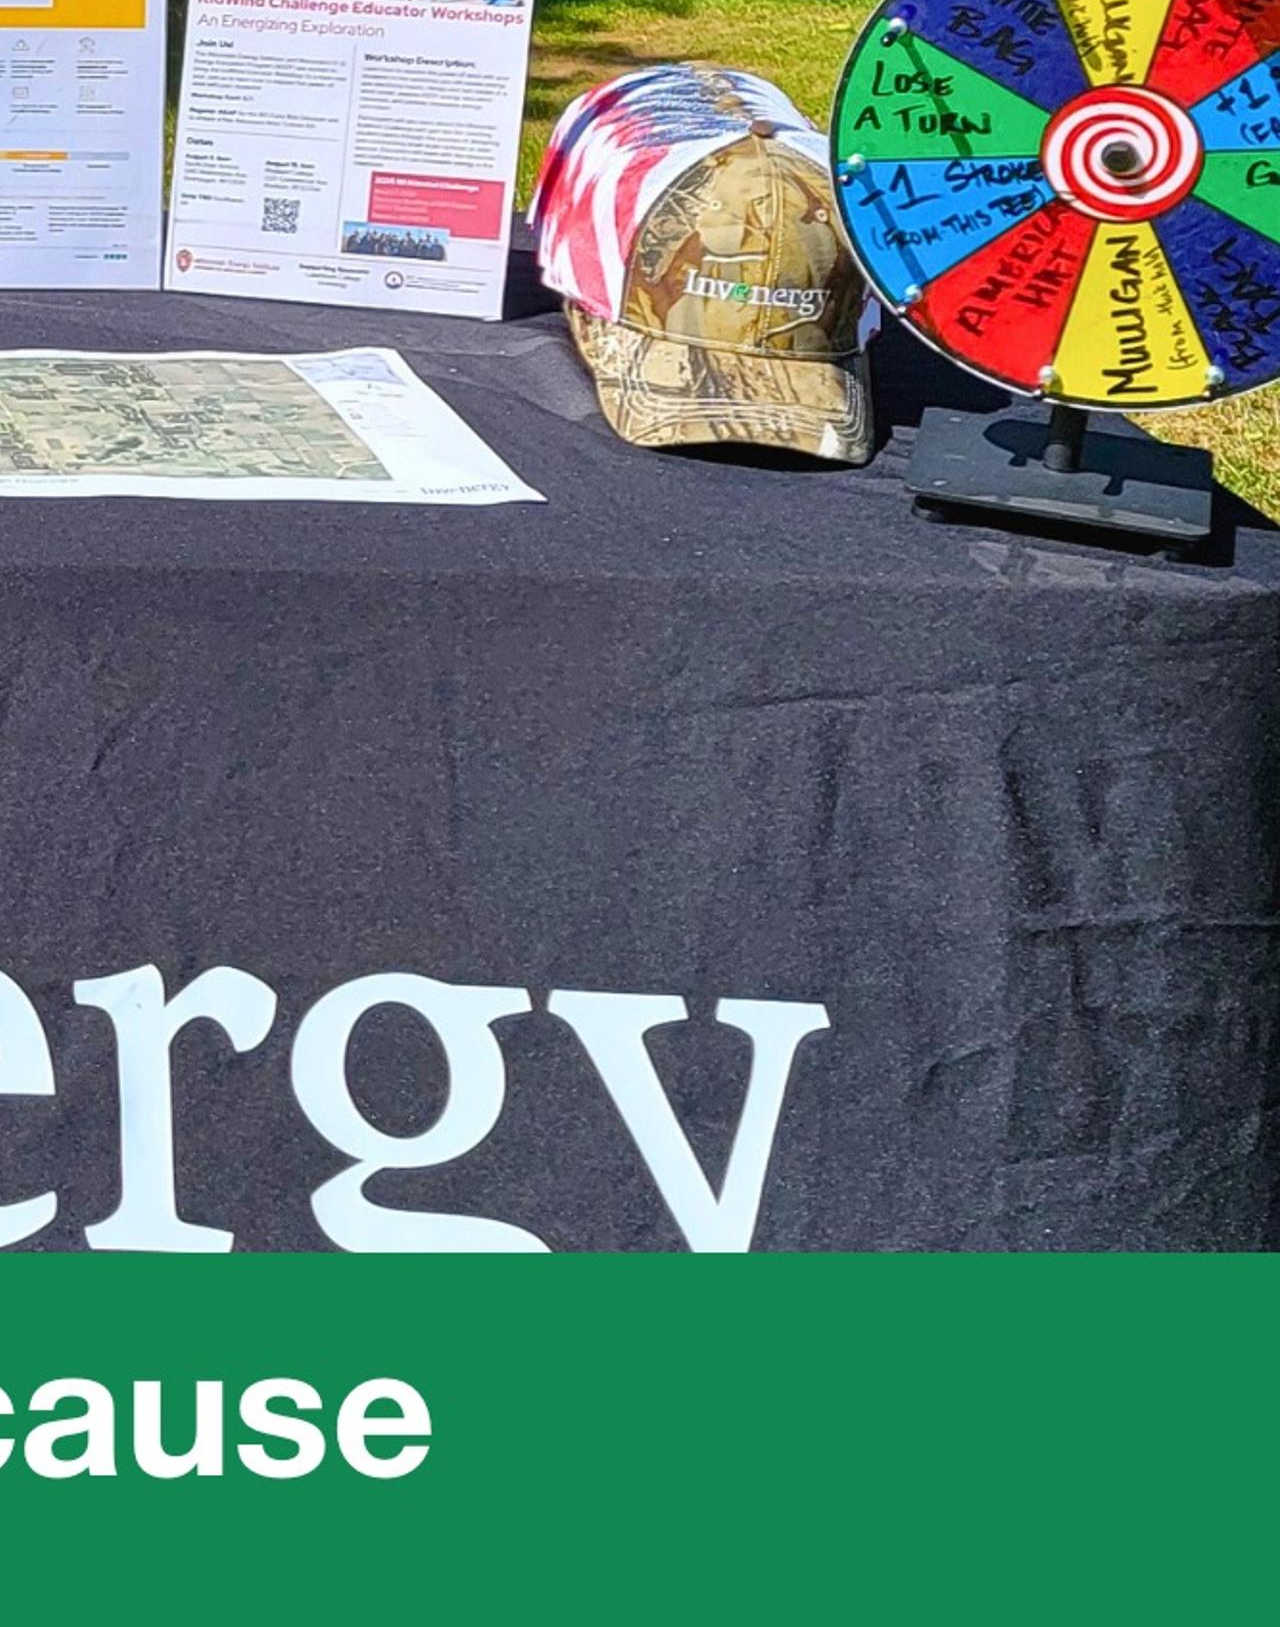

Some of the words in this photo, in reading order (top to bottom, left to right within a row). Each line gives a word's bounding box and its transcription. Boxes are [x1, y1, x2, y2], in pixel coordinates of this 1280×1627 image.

[197, 13, 219, 26] An
[221, 14, 298, 33] Energizing
[301, 19, 385, 38] Exploration
[352, 1, 427, 18] Educator
[431, 6, 525, 26] Workshops
[871, 60, 954, 97] LOSE
[853, 105, 882, 131] A
[893, 104, 991, 136] TURN
[940, 209, 991, 236] THIS
[683, 269, 831, 315] Invenergy
